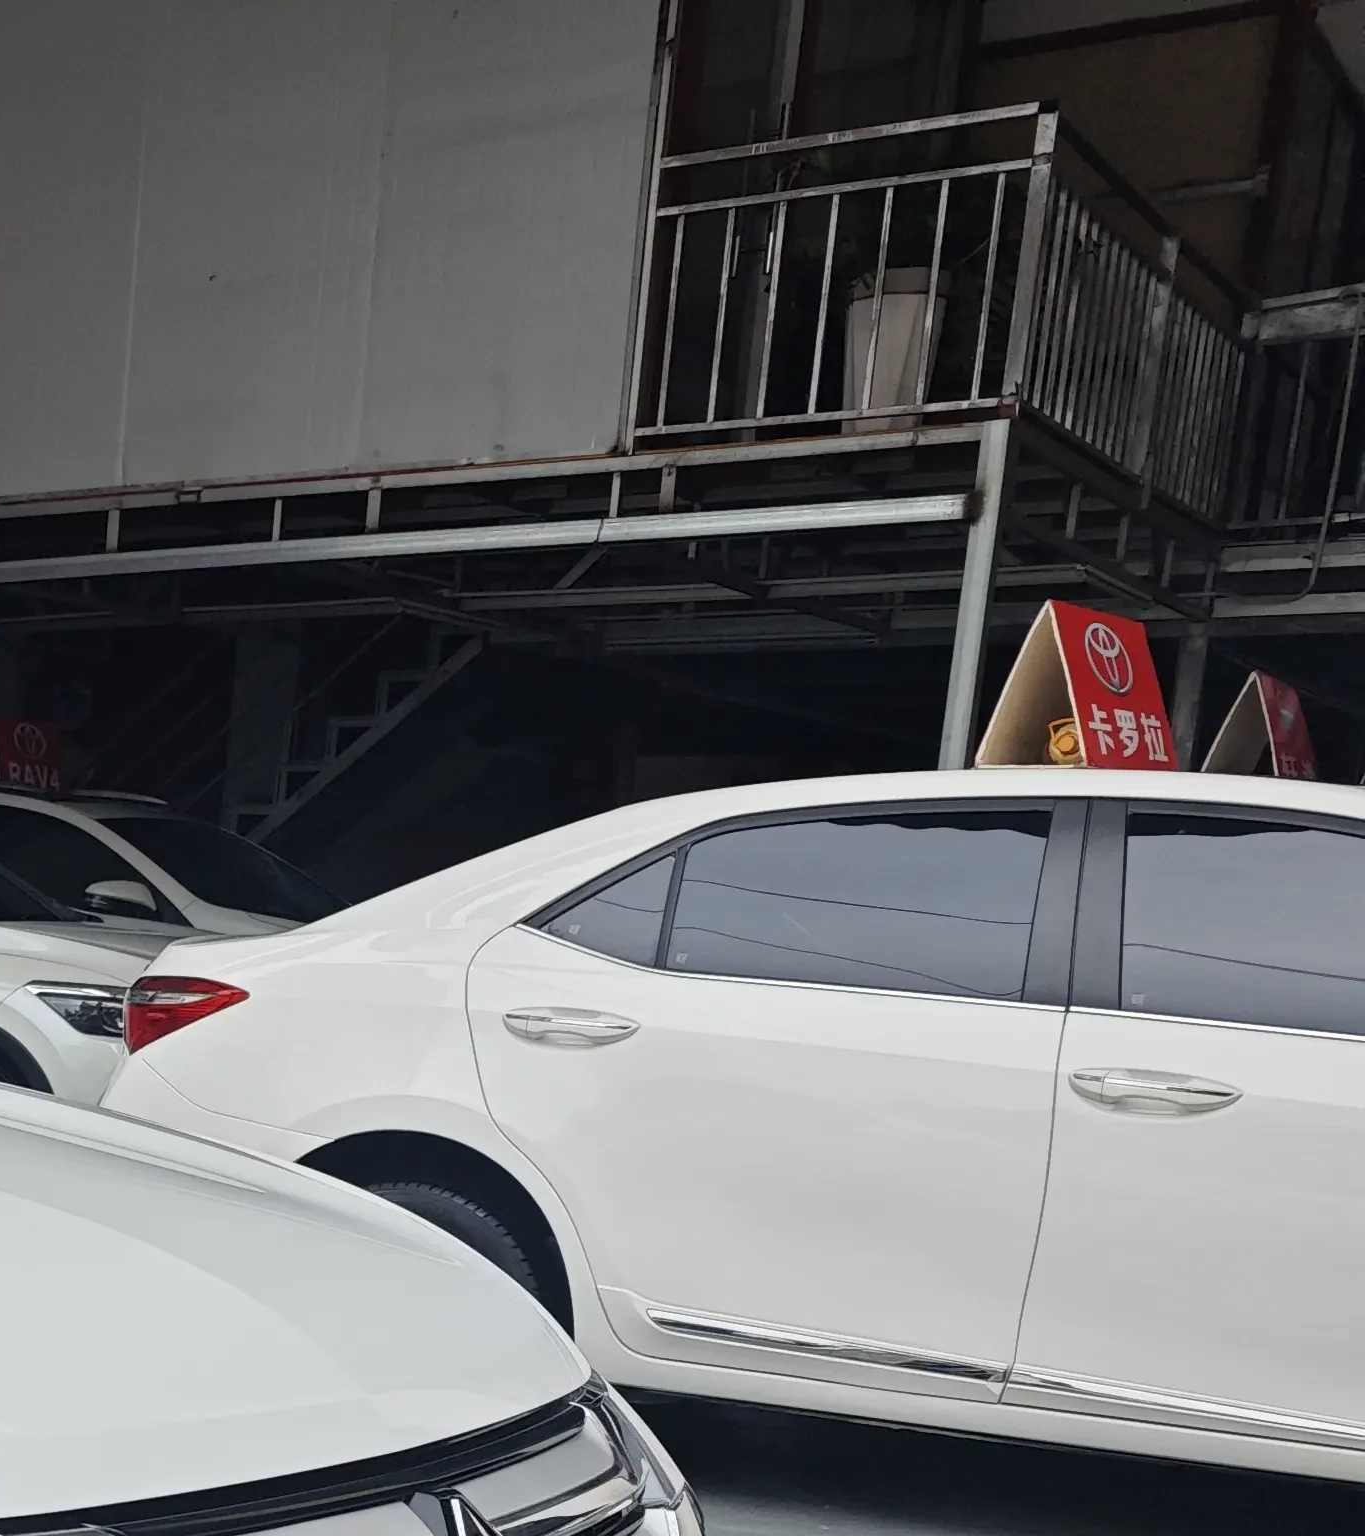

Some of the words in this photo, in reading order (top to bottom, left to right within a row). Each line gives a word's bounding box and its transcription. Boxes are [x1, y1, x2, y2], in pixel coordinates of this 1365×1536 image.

[1088, 703, 1169, 762] 卡罗拉
[9, 761, 61, 792] RAV4
